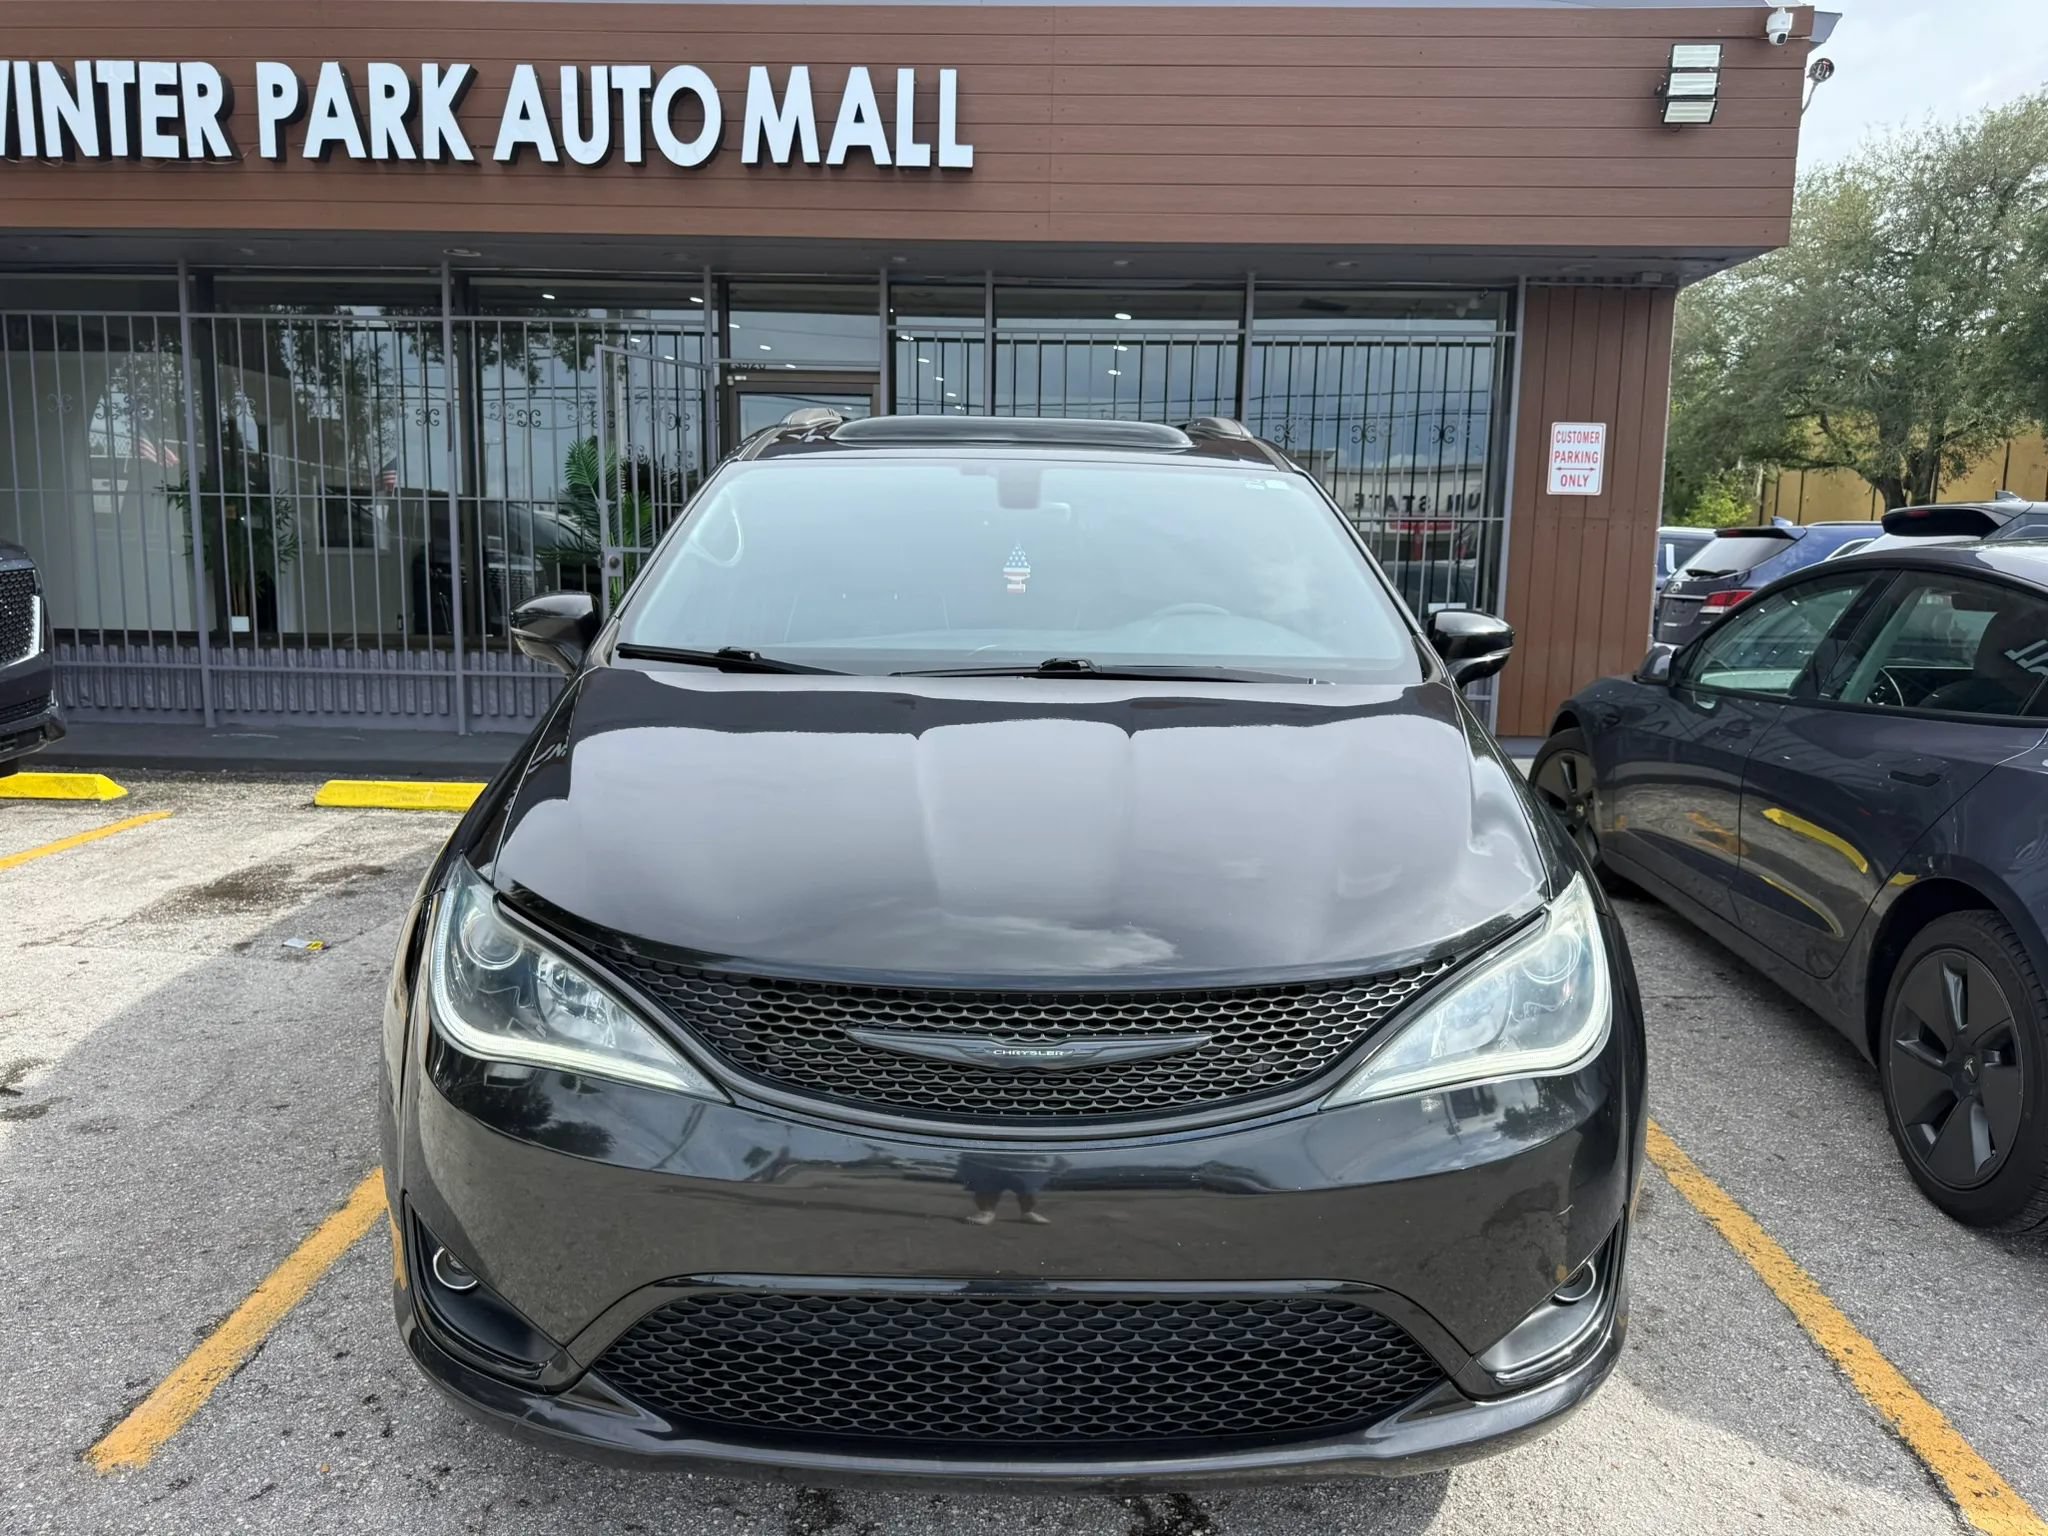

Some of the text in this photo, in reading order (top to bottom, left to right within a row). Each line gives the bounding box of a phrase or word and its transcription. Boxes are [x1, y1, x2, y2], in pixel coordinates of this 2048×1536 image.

[0, 61, 974, 168] INTER PARK AUTO MALL
[1555, 430, 1600, 445] CUSTOMER
[1553, 450, 1599, 465] PARKING
[1559, 473, 1590, 488] ONLY
